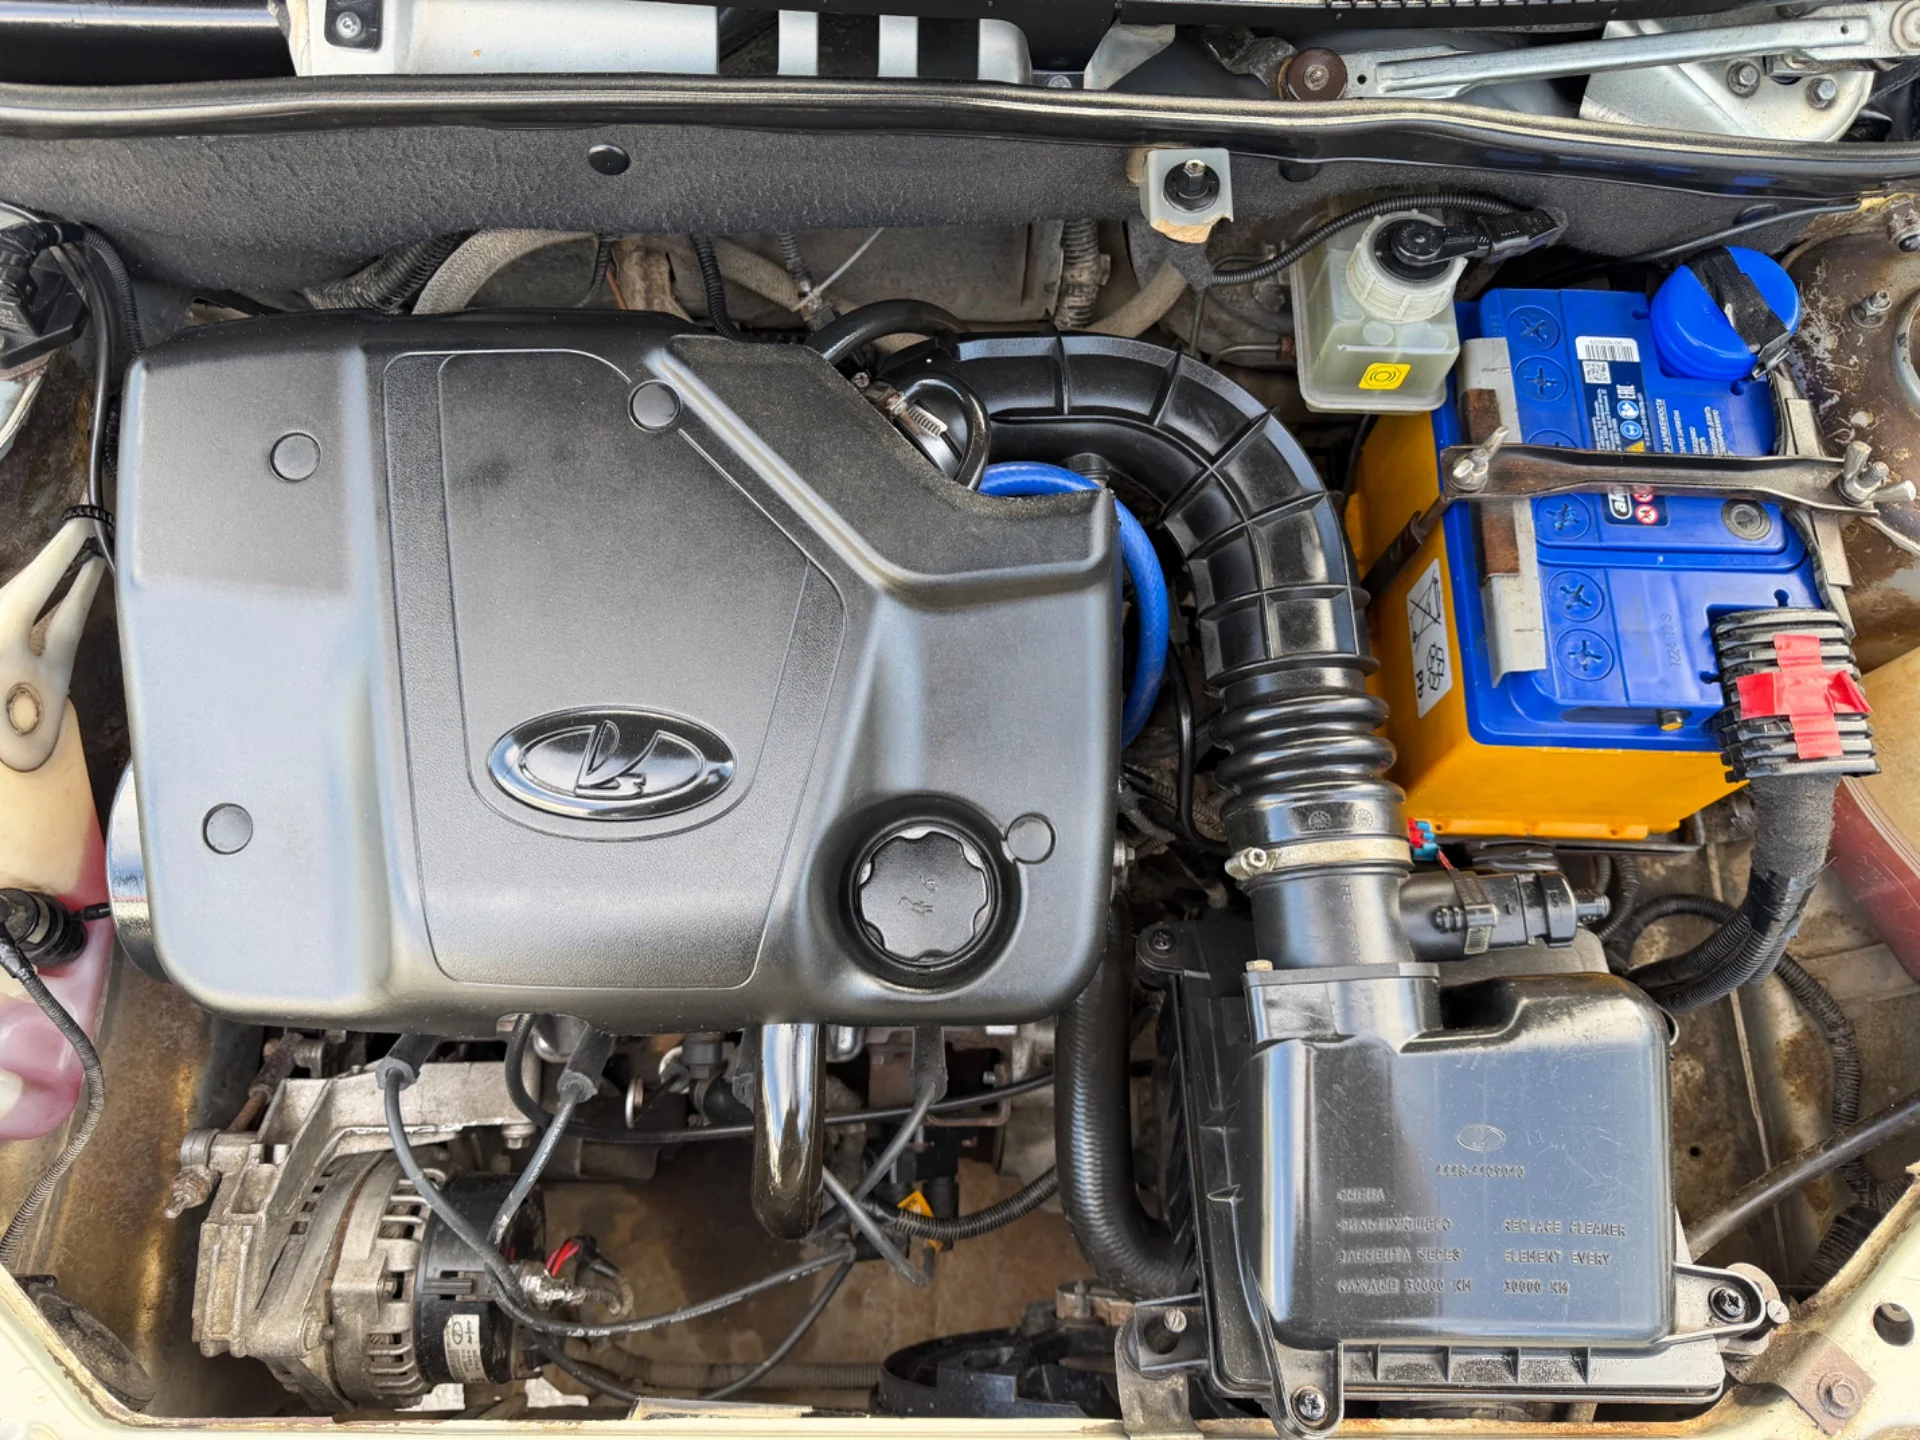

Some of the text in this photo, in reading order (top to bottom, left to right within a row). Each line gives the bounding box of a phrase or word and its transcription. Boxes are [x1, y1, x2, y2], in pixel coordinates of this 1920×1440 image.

[1416, 670, 1425, 699] Pb
[1337, 1187, 1386, 1202] СМЕНА
[1336, 1217, 1453, 1233] ФИЛЬТРУЮЩЕГО
[1503, 1219, 1626, 1237] REPLACE CLEANER
[1337, 1247, 1461, 1263] ЭЛЕМЕНТА ЧЕРЕЗ
[1503, 1249, 1611, 1266] ELEMENT EVERY
[1337, 1279, 1472, 1295] КАЖДЫЕ 30000 КМ
[1504, 1279, 1570, 1295] 30000 KM
